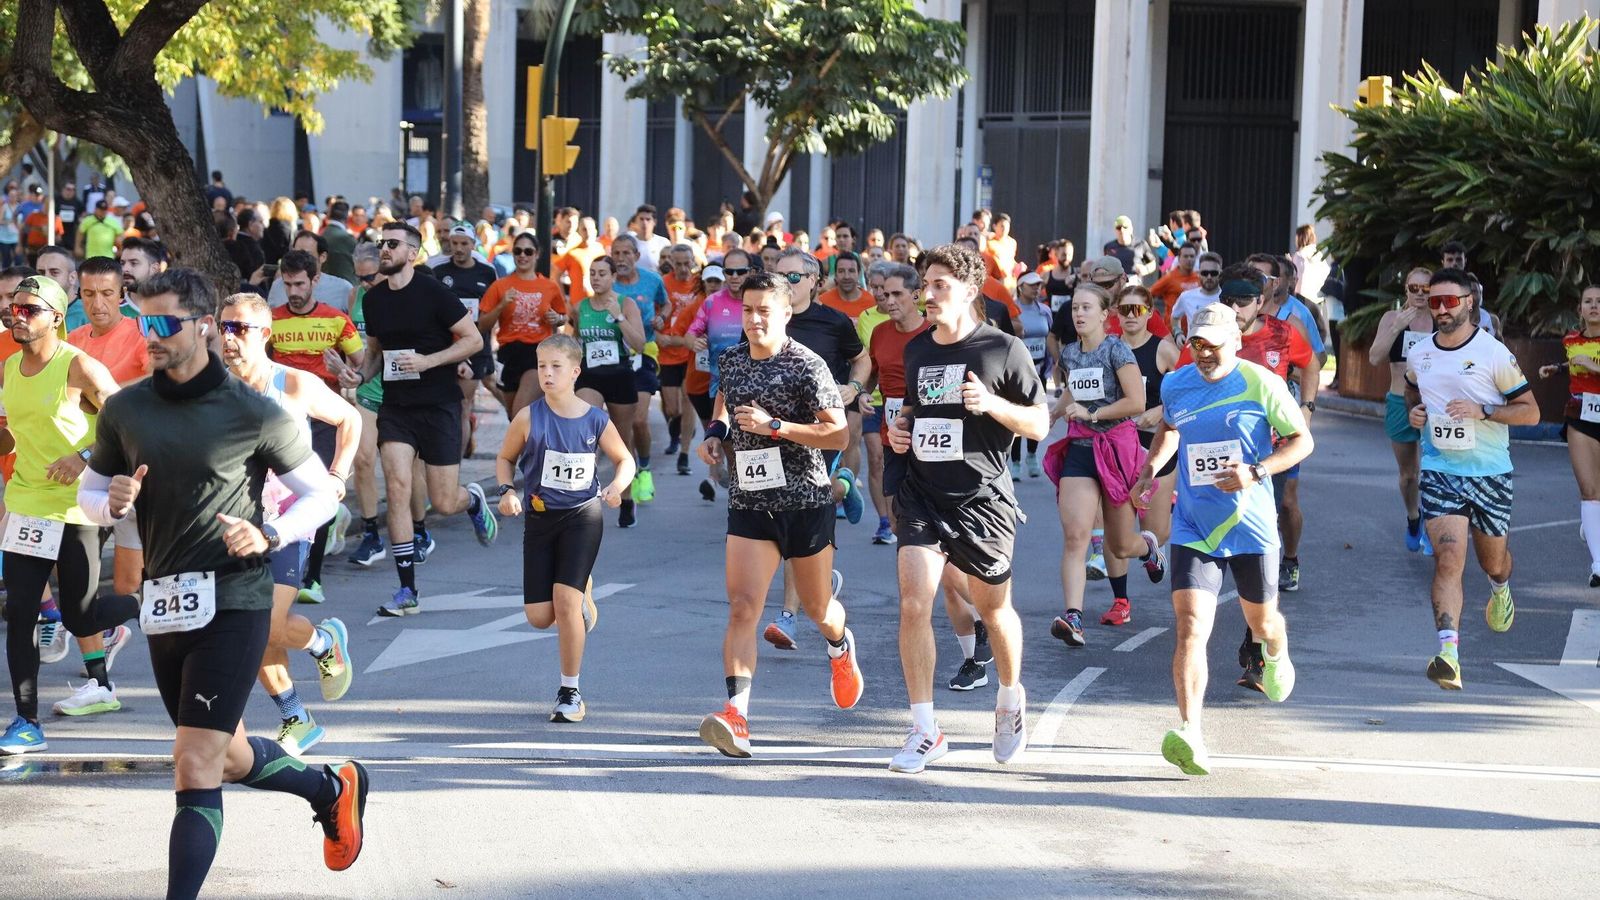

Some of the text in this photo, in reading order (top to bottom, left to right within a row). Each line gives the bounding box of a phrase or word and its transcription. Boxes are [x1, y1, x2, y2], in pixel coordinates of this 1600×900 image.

[580, 326, 616, 338] mijas
[591, 350, 613, 360] 234
[1071, 379, 1100, 390] 1009
[918, 433, 952, 448] 742
[1434, 427, 1465, 439] 976
[745, 464, 767, 479] 44
[1195, 456, 1231, 472] 937
[551, 465, 586, 480] 112
[18, 526, 44, 544] 53
[152, 593, 199, 617] 843
